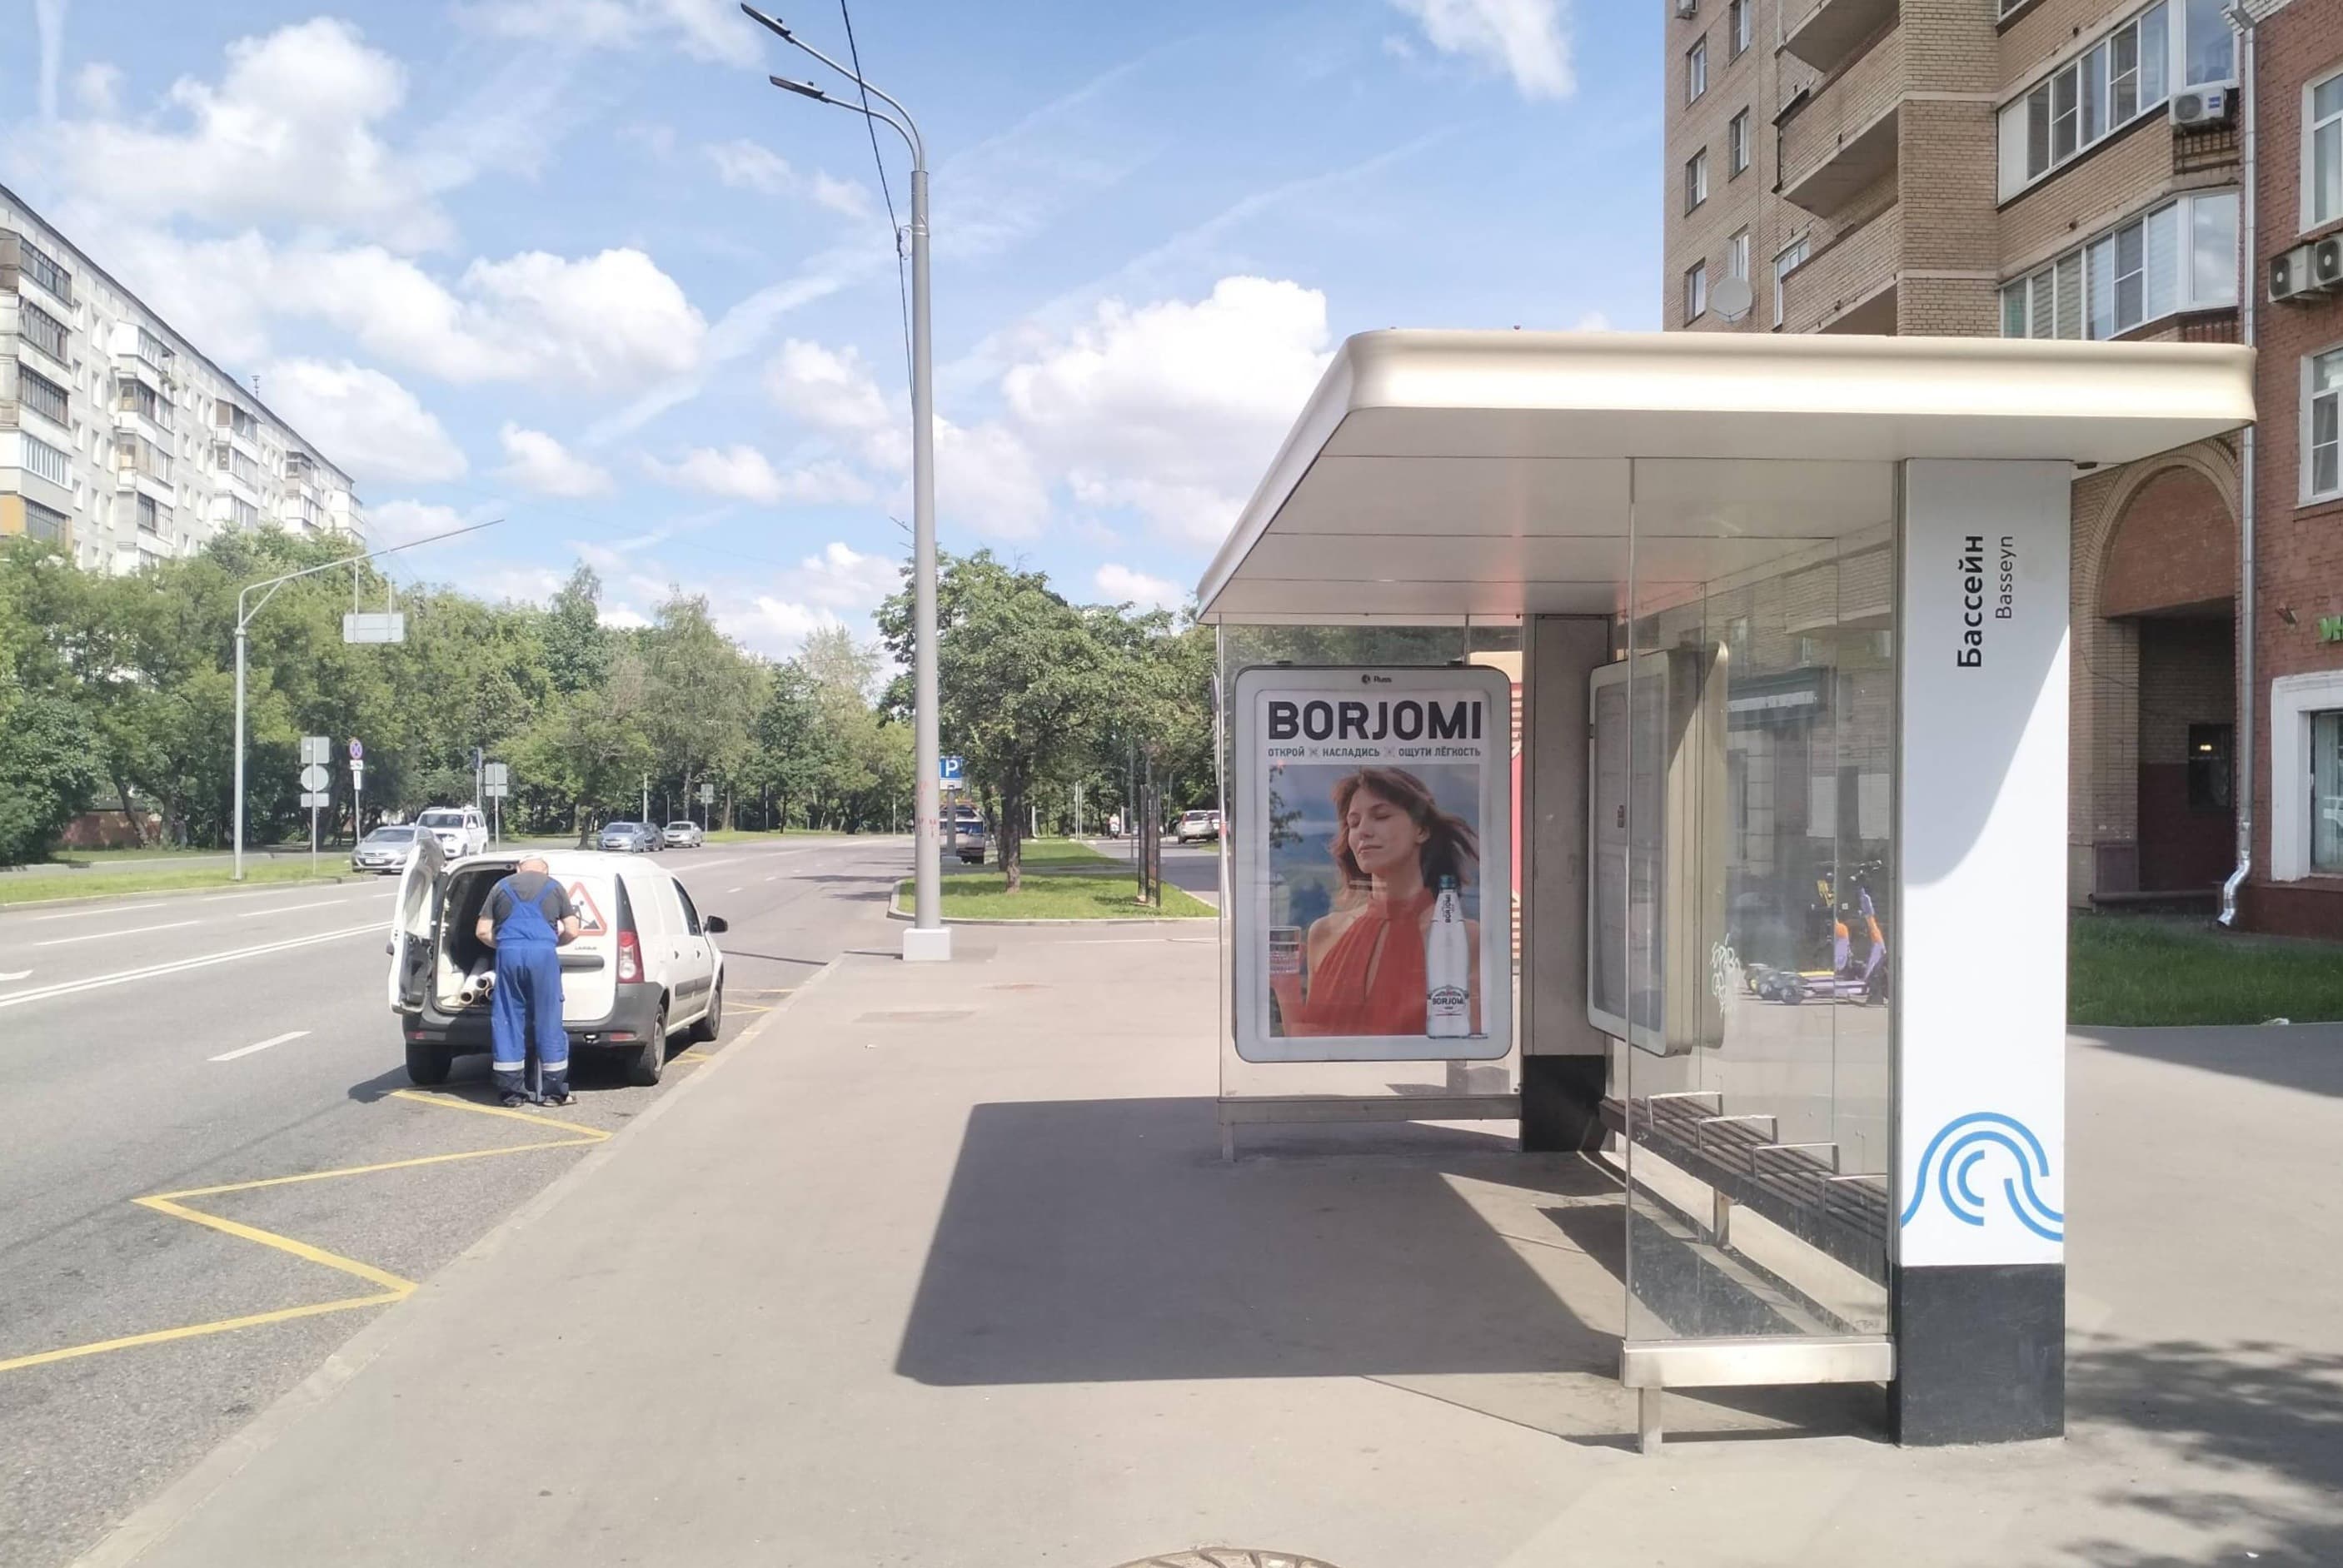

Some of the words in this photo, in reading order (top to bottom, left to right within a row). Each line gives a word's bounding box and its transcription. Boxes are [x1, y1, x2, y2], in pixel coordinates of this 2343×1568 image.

[1996, 535, 2016, 619] Basseyn
[1957, 535, 1983, 667] Бассейн
[1269, 700, 1482, 740] BORJOMI
[945, 759, 959, 777] P
[1268, 746, 1305, 757] ОТКРОЙ
[1323, 748, 1380, 758] НАСЛАДИСЬ
[1398, 748, 1432, 758] ОЩУТИ
[1434, 746, 1481, 757] ЛЁГКОСТЬ
